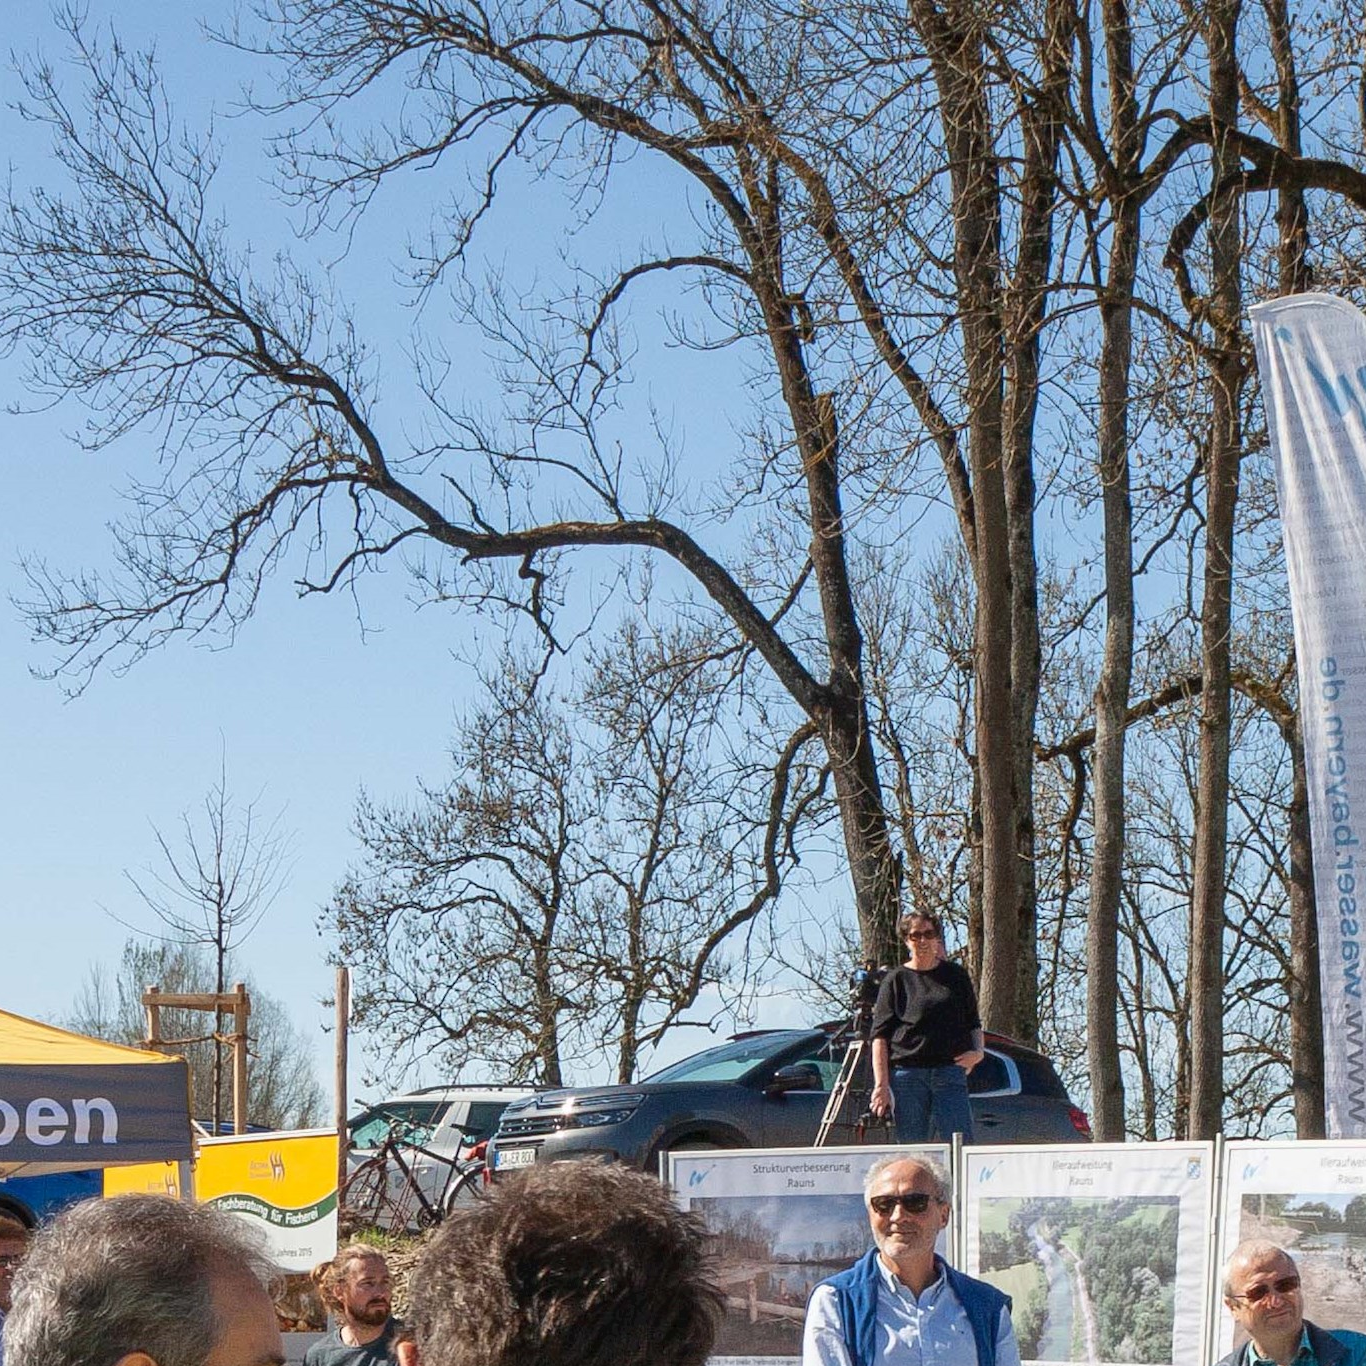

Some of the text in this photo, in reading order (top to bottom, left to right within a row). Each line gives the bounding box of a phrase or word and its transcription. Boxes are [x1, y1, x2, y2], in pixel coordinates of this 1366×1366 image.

[753, 1163, 852, 1176] Strukturverbesserung
[787, 1178, 816, 1188] Rauns
[270, 1208, 284, 1223] für
[285, 1207, 319, 1225] Fischerei
